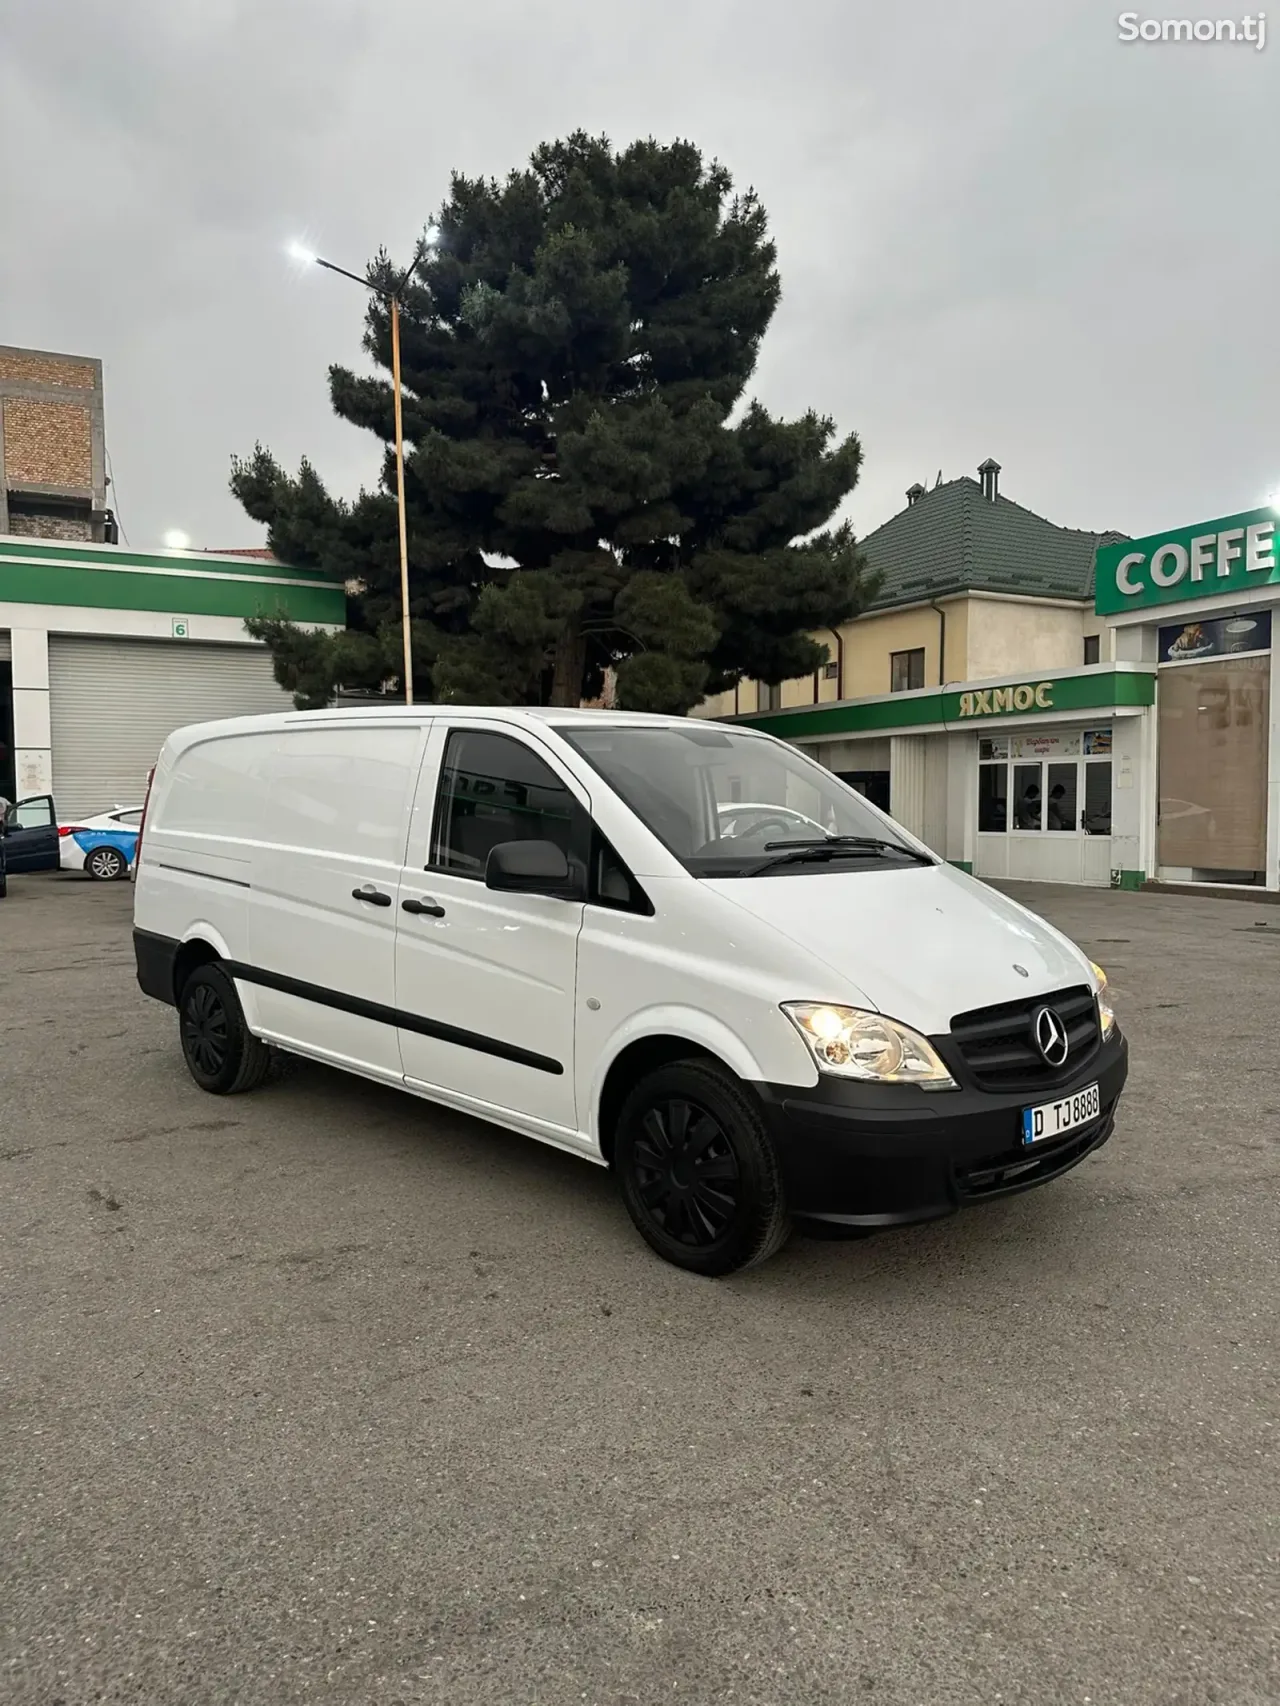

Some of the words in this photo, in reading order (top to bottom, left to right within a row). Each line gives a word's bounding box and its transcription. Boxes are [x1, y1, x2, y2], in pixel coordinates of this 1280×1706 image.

[1115, 520, 1276, 595] COFFE
[175, 624, 186, 636] 6
[959, 682, 1054, 717] ЯХМОС
[1034, 1109, 1044, 1136] D
